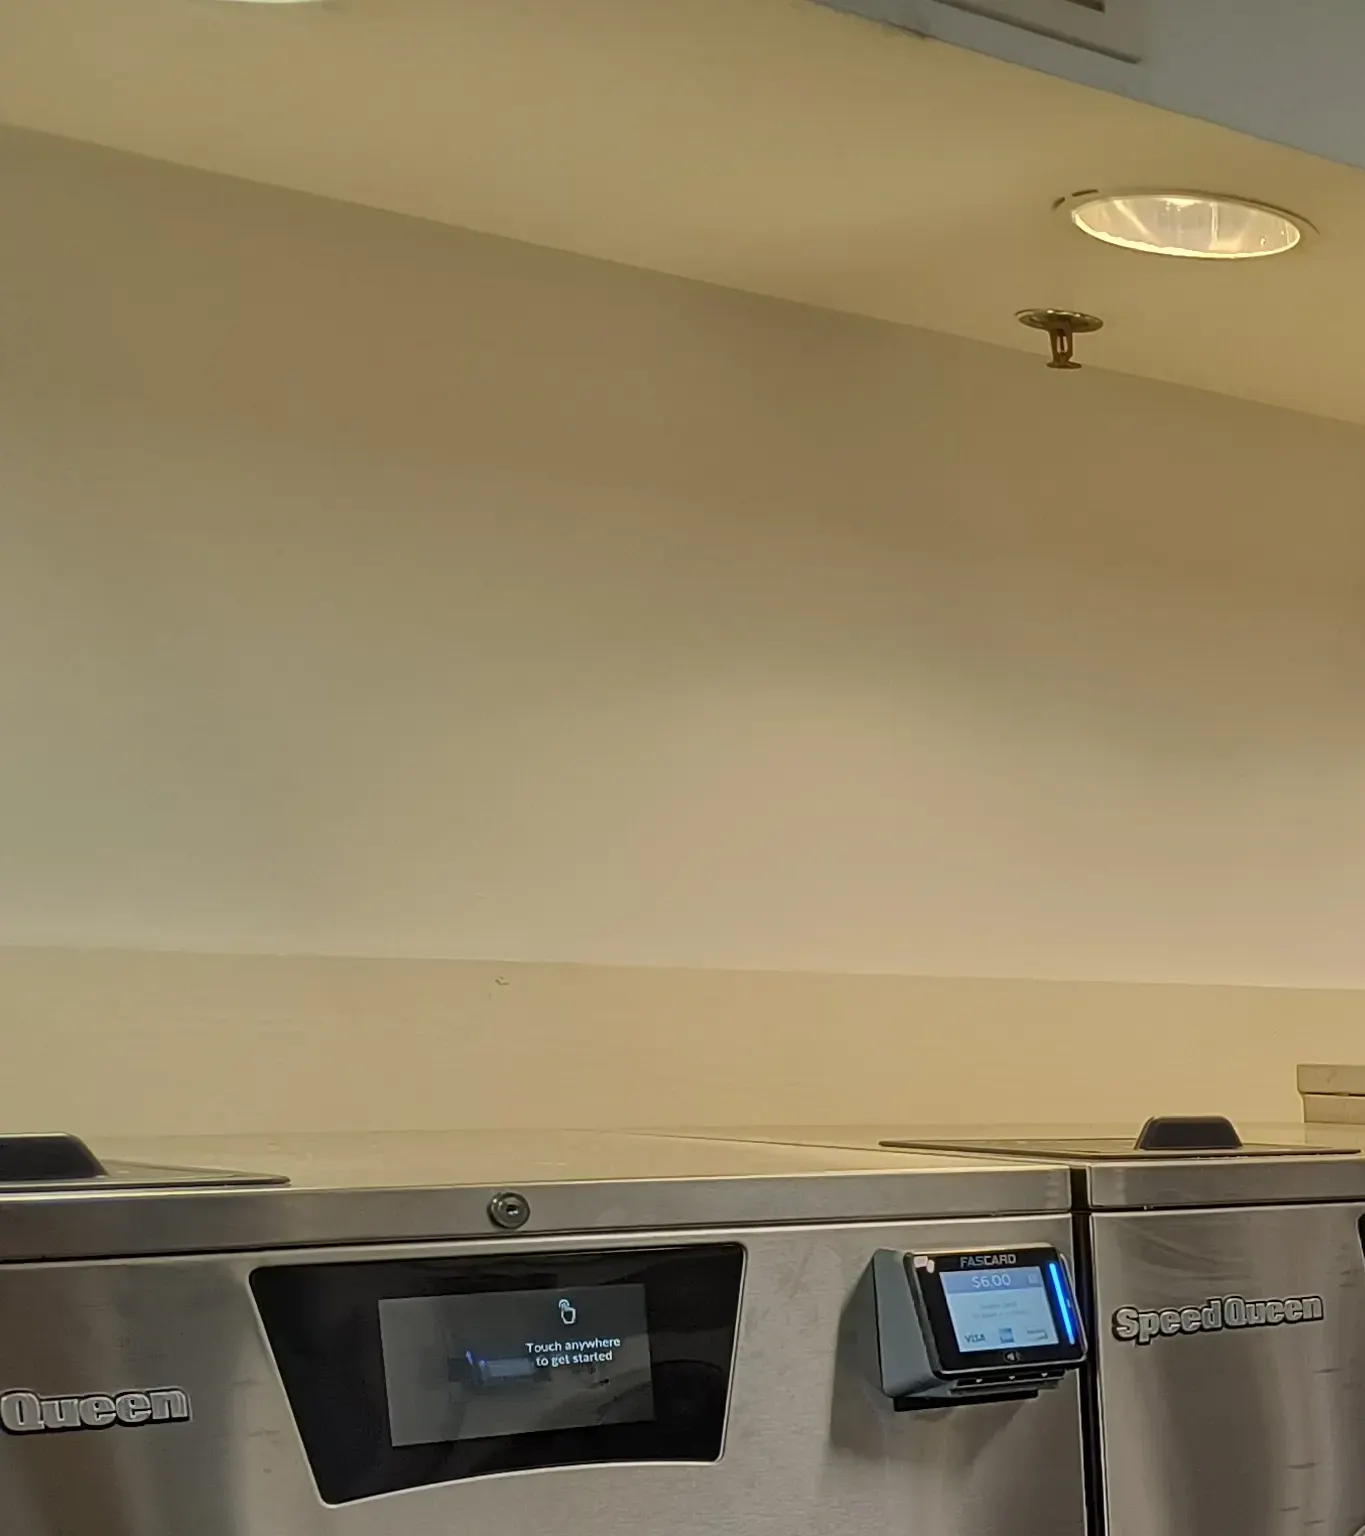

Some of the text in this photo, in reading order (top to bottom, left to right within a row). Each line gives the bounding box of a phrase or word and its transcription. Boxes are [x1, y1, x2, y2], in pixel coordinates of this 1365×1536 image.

[960, 1253, 1017, 1268] FASCARD
[971, 1273, 1012, 1289] $6.00
[525, 1337, 621, 1354] Touch anywhere
[535, 1350, 614, 1368] to get started
[0, 1390, 191, 1434] Queen
